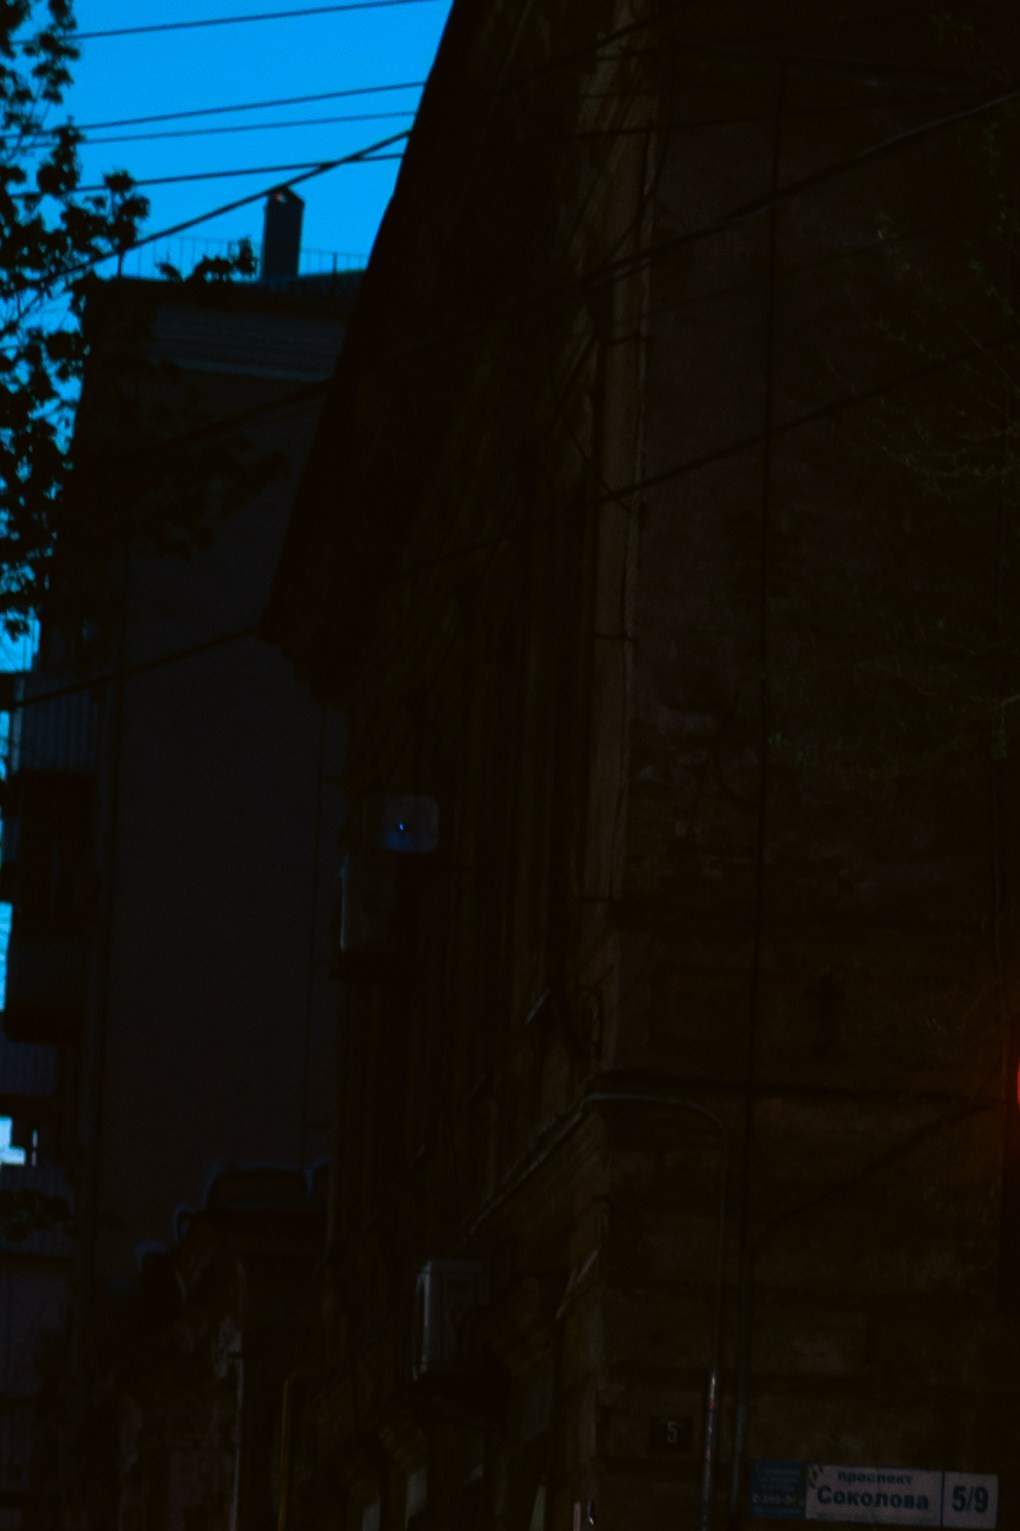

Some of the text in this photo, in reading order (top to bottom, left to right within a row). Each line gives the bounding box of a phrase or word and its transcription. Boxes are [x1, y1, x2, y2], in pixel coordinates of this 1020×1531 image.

[666, 1419, 678, 1444] 5
[838, 1471, 913, 1484] проспект
[817, 1485, 929, 1511] Соколова
[951, 1485, 989, 1514] 5/9
